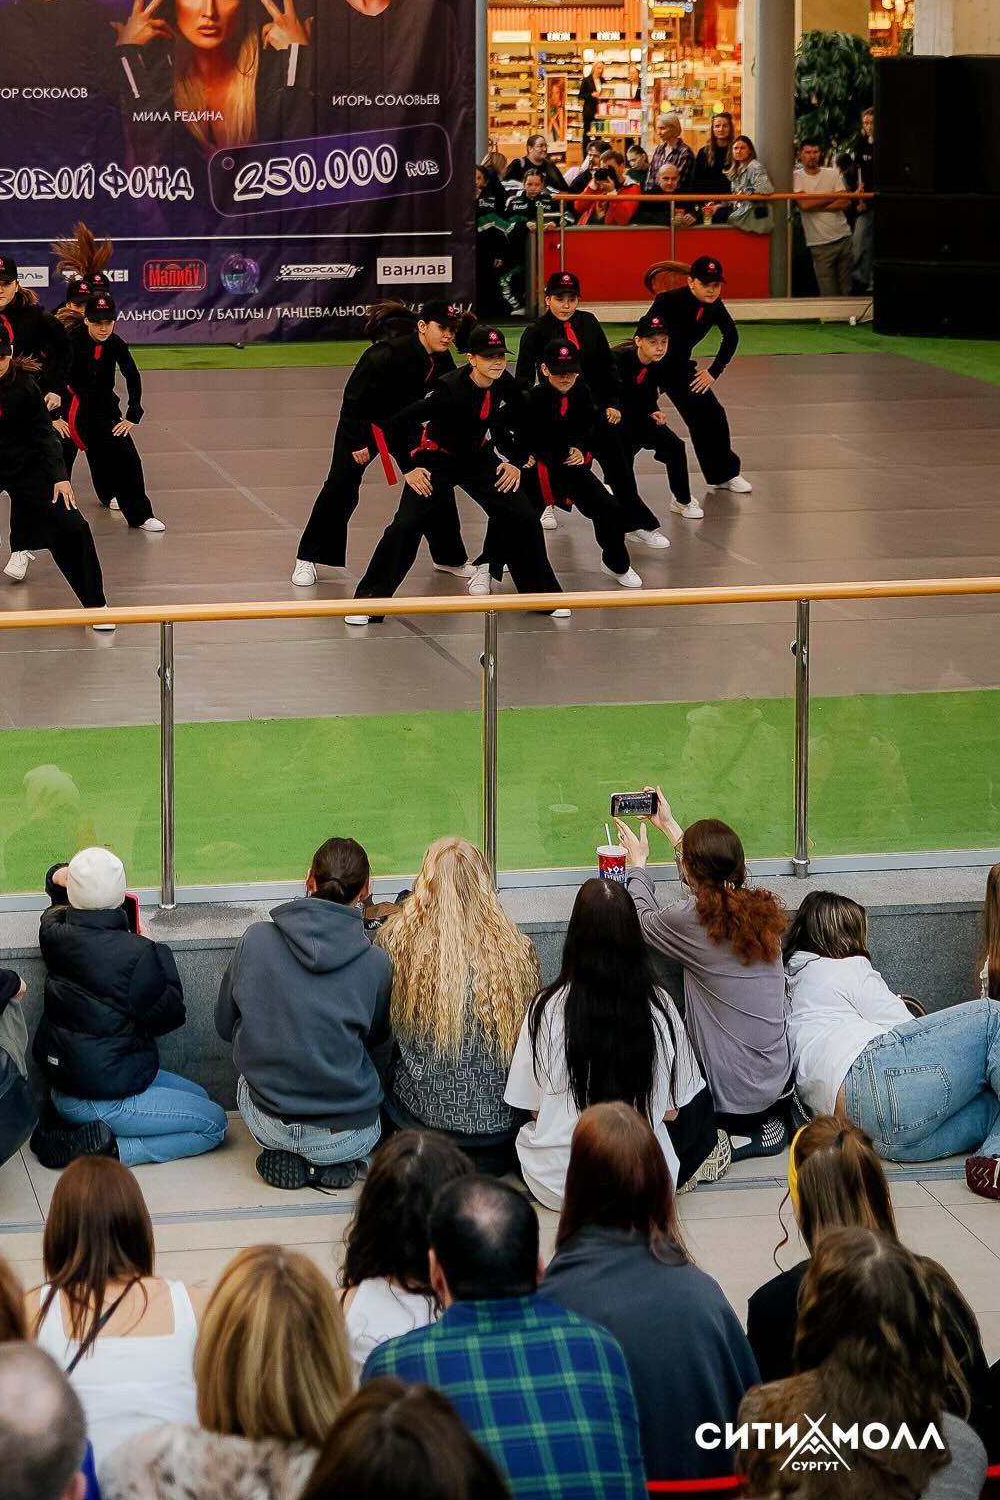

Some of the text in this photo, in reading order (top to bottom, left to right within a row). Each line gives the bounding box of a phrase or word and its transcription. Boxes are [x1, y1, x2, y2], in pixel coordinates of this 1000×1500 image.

[22, 87, 88, 100] СОКОЛОВ
[332, 93, 440, 107] ИГОРЬ СОЛОВЬЕВ
[132, 111, 224, 123] МИЛА РЕДИНА
[233, 144, 440, 202] 250.000 RUB
[98, 161, 195, 201] ФОНД
[381, 263, 447, 277] ванлав
[172, 307, 205, 321] ШОУ
[217, 306, 264, 321] БАТТЛЫ
